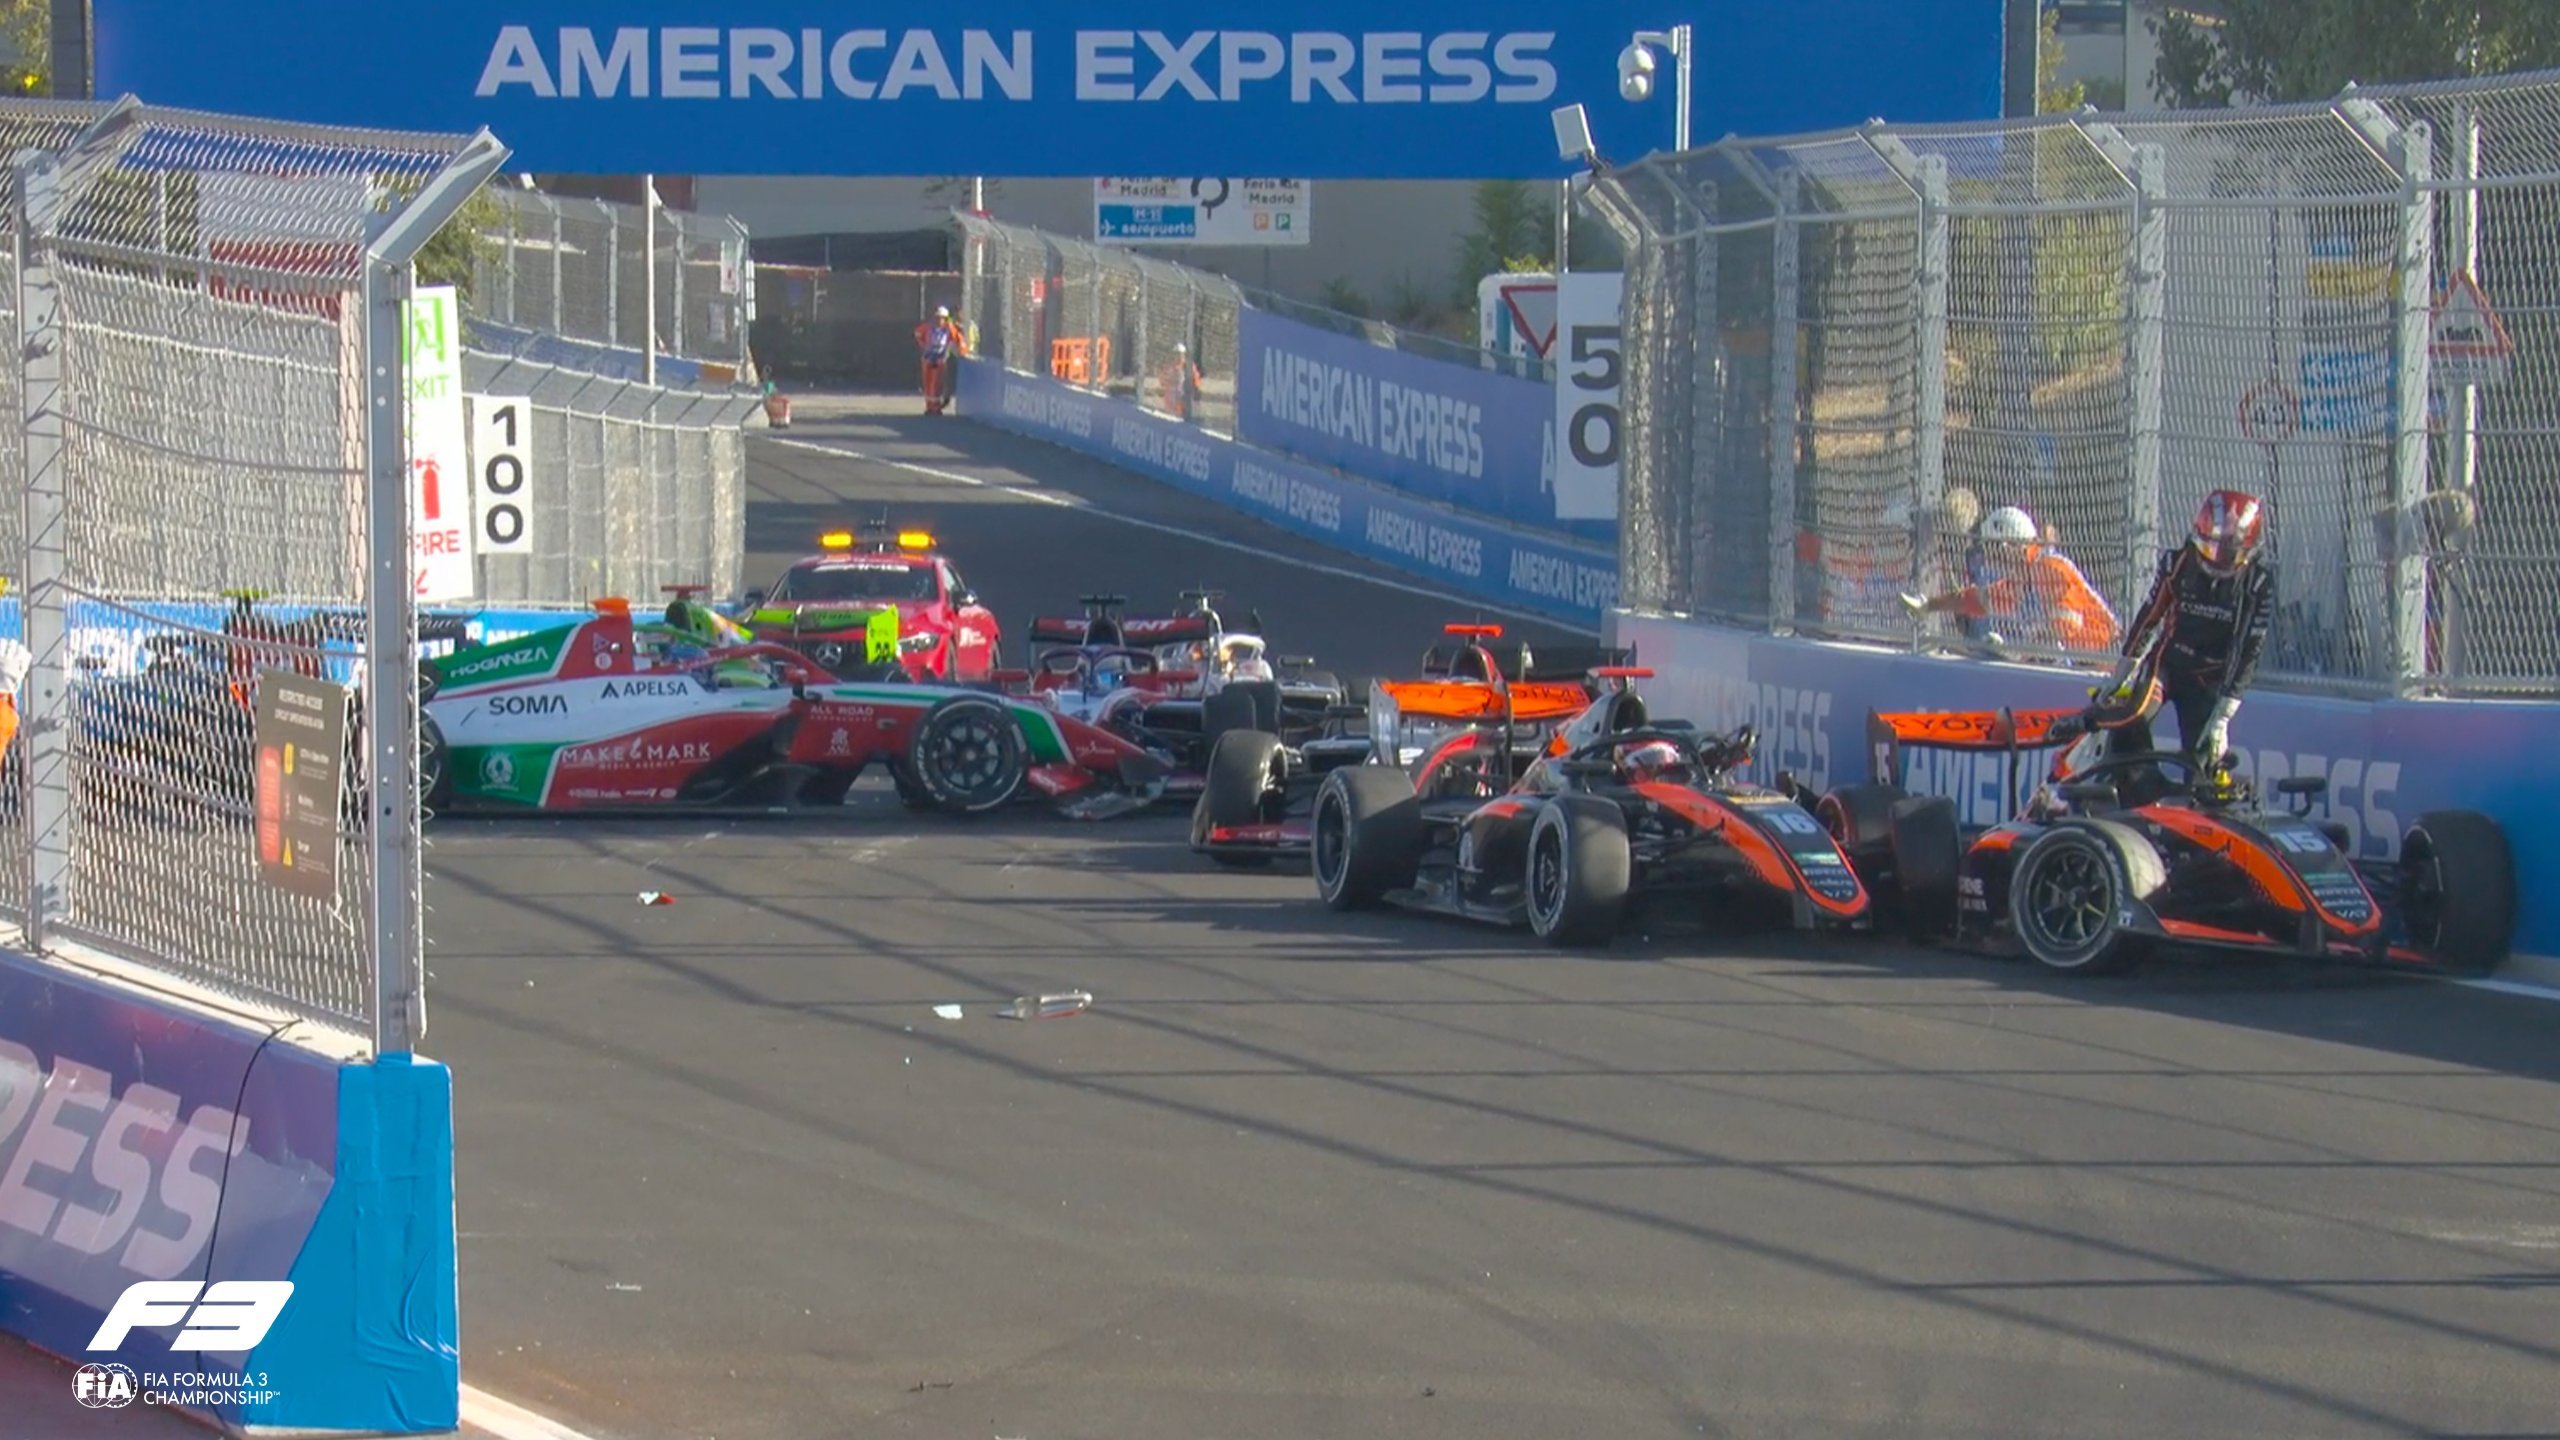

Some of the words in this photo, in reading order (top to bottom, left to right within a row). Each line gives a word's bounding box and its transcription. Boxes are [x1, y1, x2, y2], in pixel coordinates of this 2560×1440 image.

[475, 25, 1032, 100] AMERICAN
[1076, 30, 1556, 103] EXPRESS
[1120, 185, 1167, 197] Madrid
[1249, 192, 1295, 204] Madrid
[1121, 222, 1195, 237] aeropuerto
[1003, 383, 1048, 425] AMERICAN
[1049, 396, 1092, 438] EXPRESS
[1261, 347, 1374, 448] AMERICAN
[1380, 379, 1484, 480] EXPRESS
[1570, 325, 1623, 468] 50
[485, 405, 523, 545] 100
[1111, 416, 1163, 464] AMERICAN
[1164, 433, 1211, 482] EXPRESS
[1231, 458, 1287, 513] AMERICAN
[1288, 479, 1341, 532] EXPRESS
[1365, 504, 1426, 560] AMERICAN
[1428, 525, 1483, 577] EXPRESS
[1508, 547, 1574, 604] AMERICAN
[489, 694, 568, 716] SOMA
[623, 681, 689, 697] APELSA
[562, 745, 624, 762] MAKE
[648, 742, 711, 760] MARK
[1763, 812, 1818, 835] 16
[2268, 830, 2328, 852] 15
